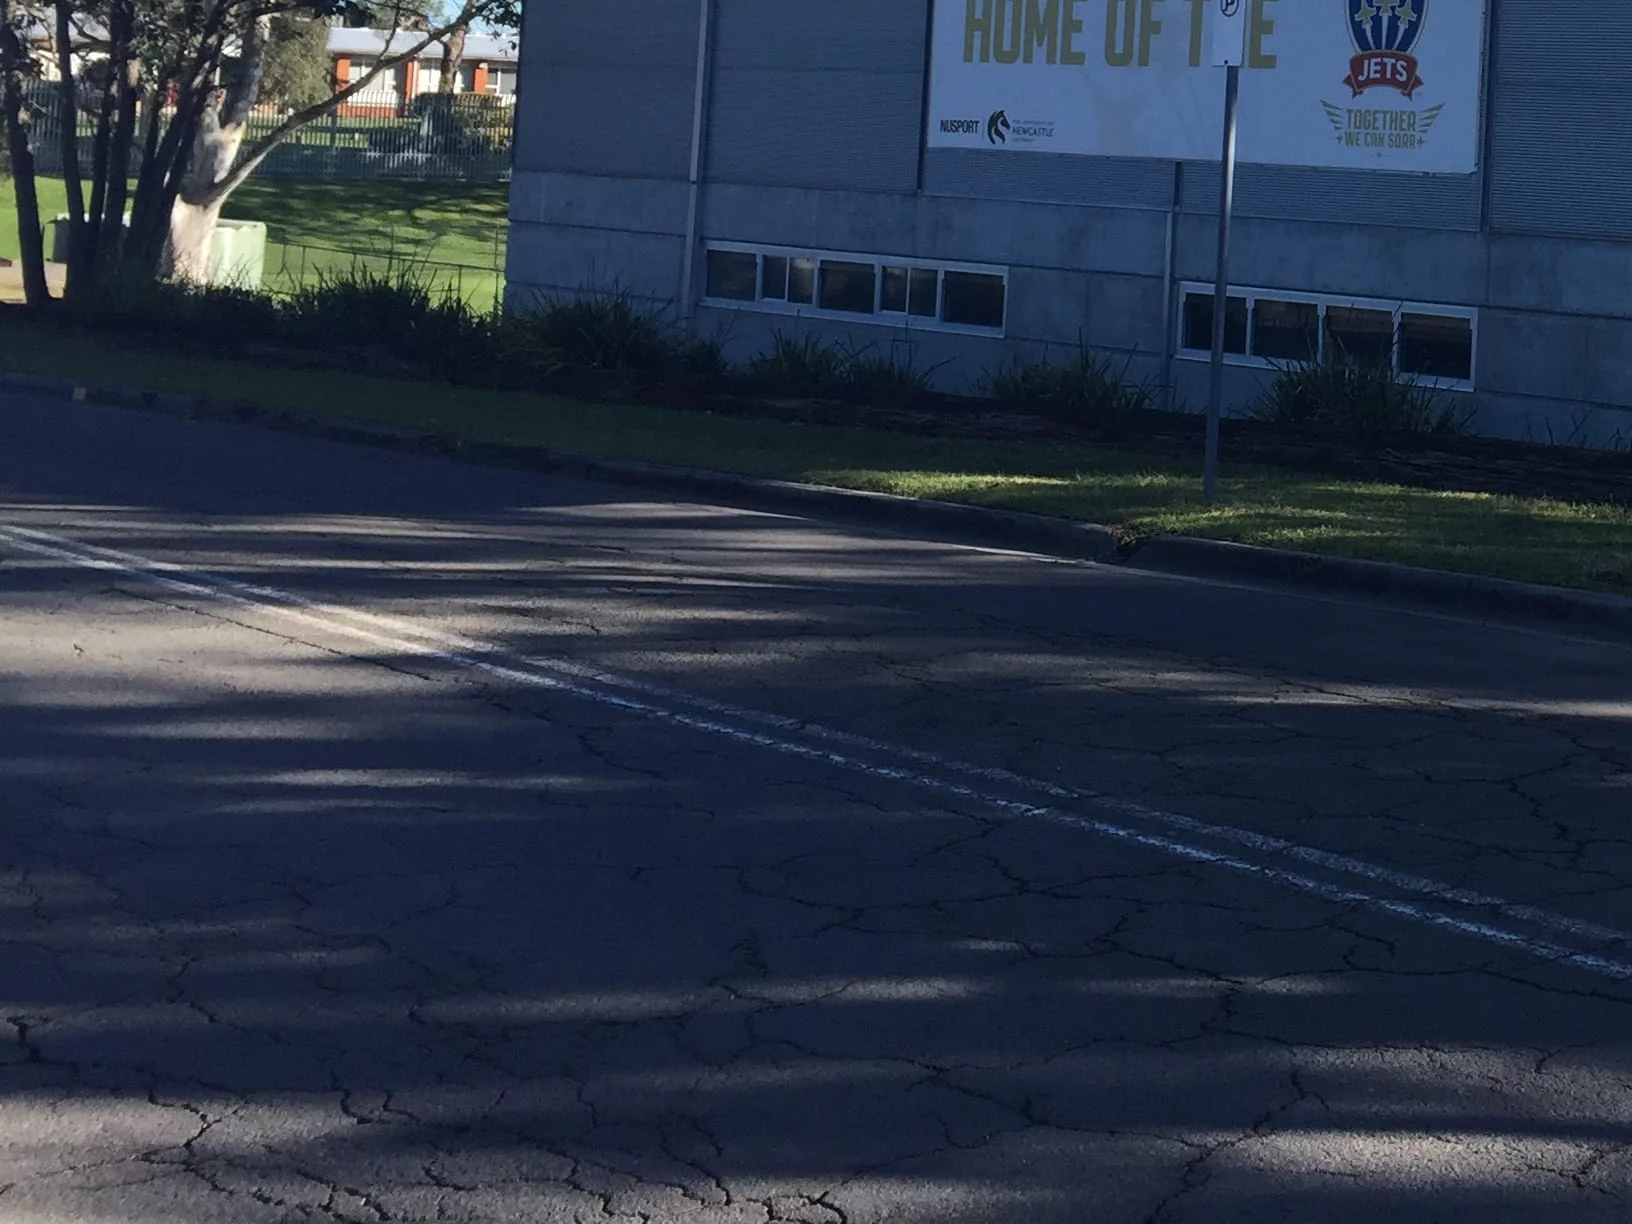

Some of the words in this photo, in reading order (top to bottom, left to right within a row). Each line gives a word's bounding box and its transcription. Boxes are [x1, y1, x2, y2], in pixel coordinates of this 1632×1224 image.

[1357, 57, 1407, 81] JETS
[940, 119, 980, 134] NUSPORT
[1346, 108, 1416, 132] TOGETHER
[1012, 126, 1054, 137] NEWCASTLE
[1344, 131, 1361, 147] WE
[1364, 132, 1385, 148] CAN
[1387, 133, 1416, 149] SOAR
